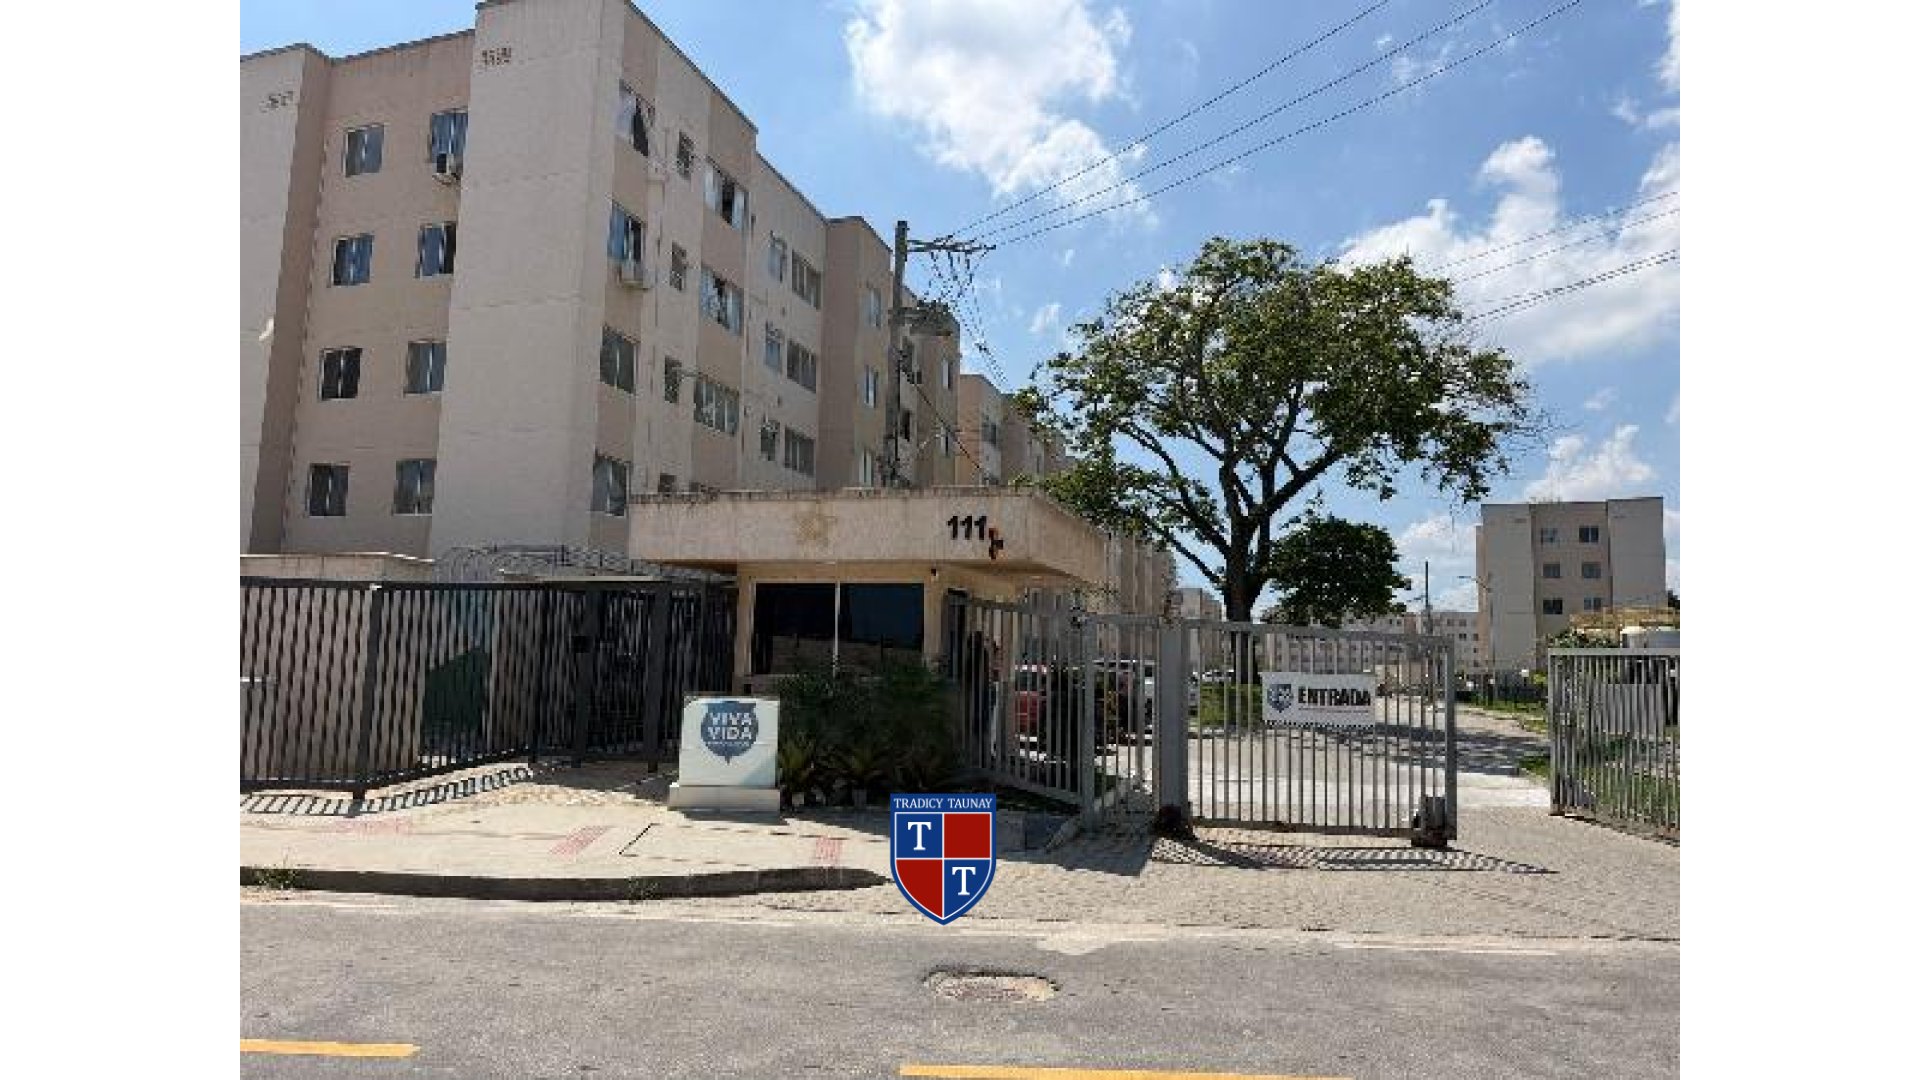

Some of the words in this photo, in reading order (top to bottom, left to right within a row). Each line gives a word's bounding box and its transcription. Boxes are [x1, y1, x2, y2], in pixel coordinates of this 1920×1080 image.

[1298, 687, 1371, 706] ENTRADA
[709, 712, 751, 726] VIVA
[707, 726, 752, 740] VIDA
